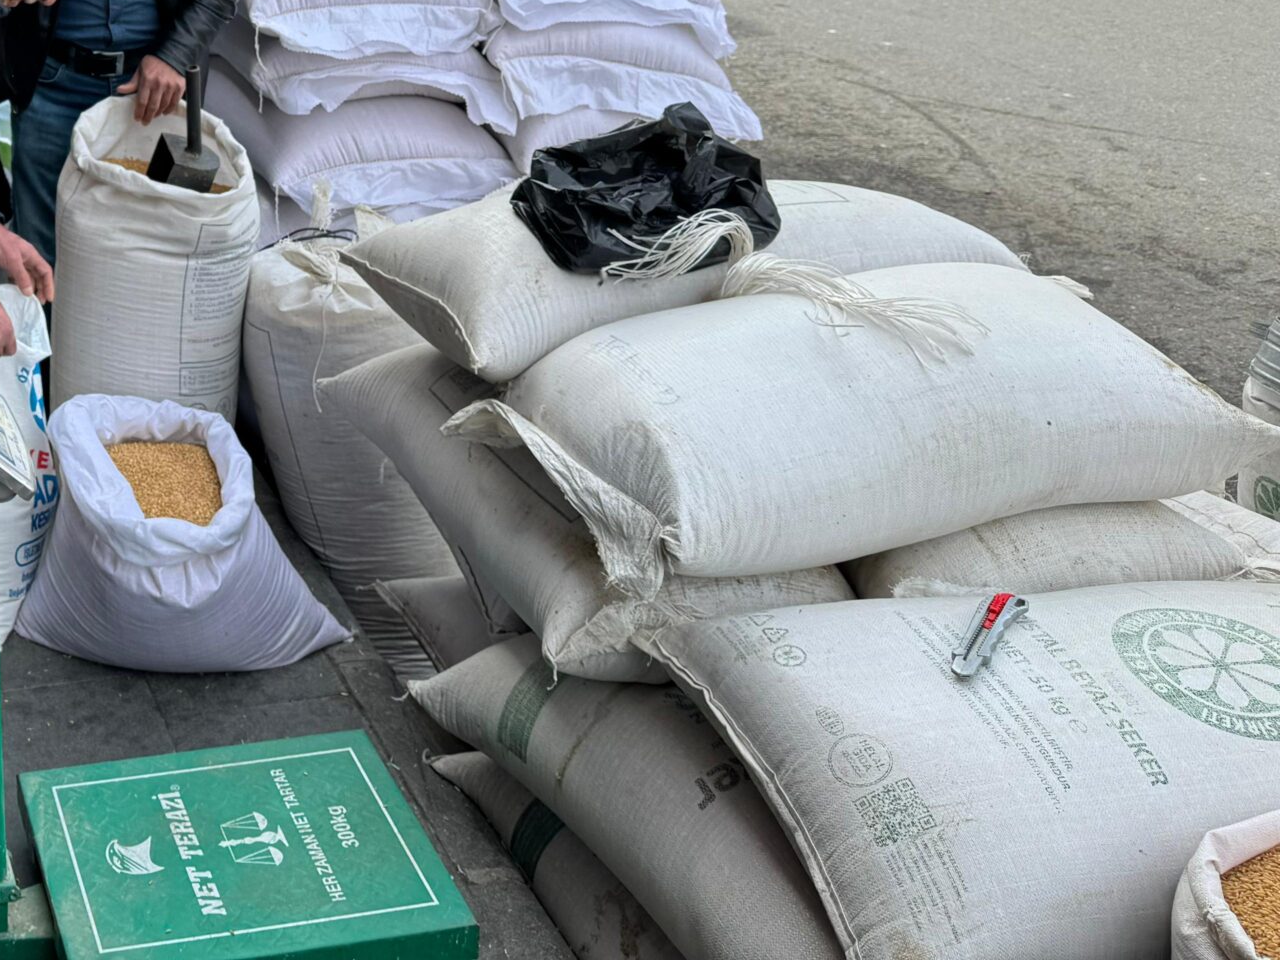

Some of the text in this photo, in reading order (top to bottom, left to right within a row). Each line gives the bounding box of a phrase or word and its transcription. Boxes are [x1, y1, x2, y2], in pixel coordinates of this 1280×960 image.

[1048, 696, 1071, 715] kg
[1060, 659, 1122, 716] BEYAZ
[1106, 719, 1168, 787] ŞEKER
[270, 768, 300, 809] TARTAR
[151, 790, 227, 915] NET TERAZİ
[301, 833, 333, 875] ZAMAN
[322, 875, 346, 902] HER
